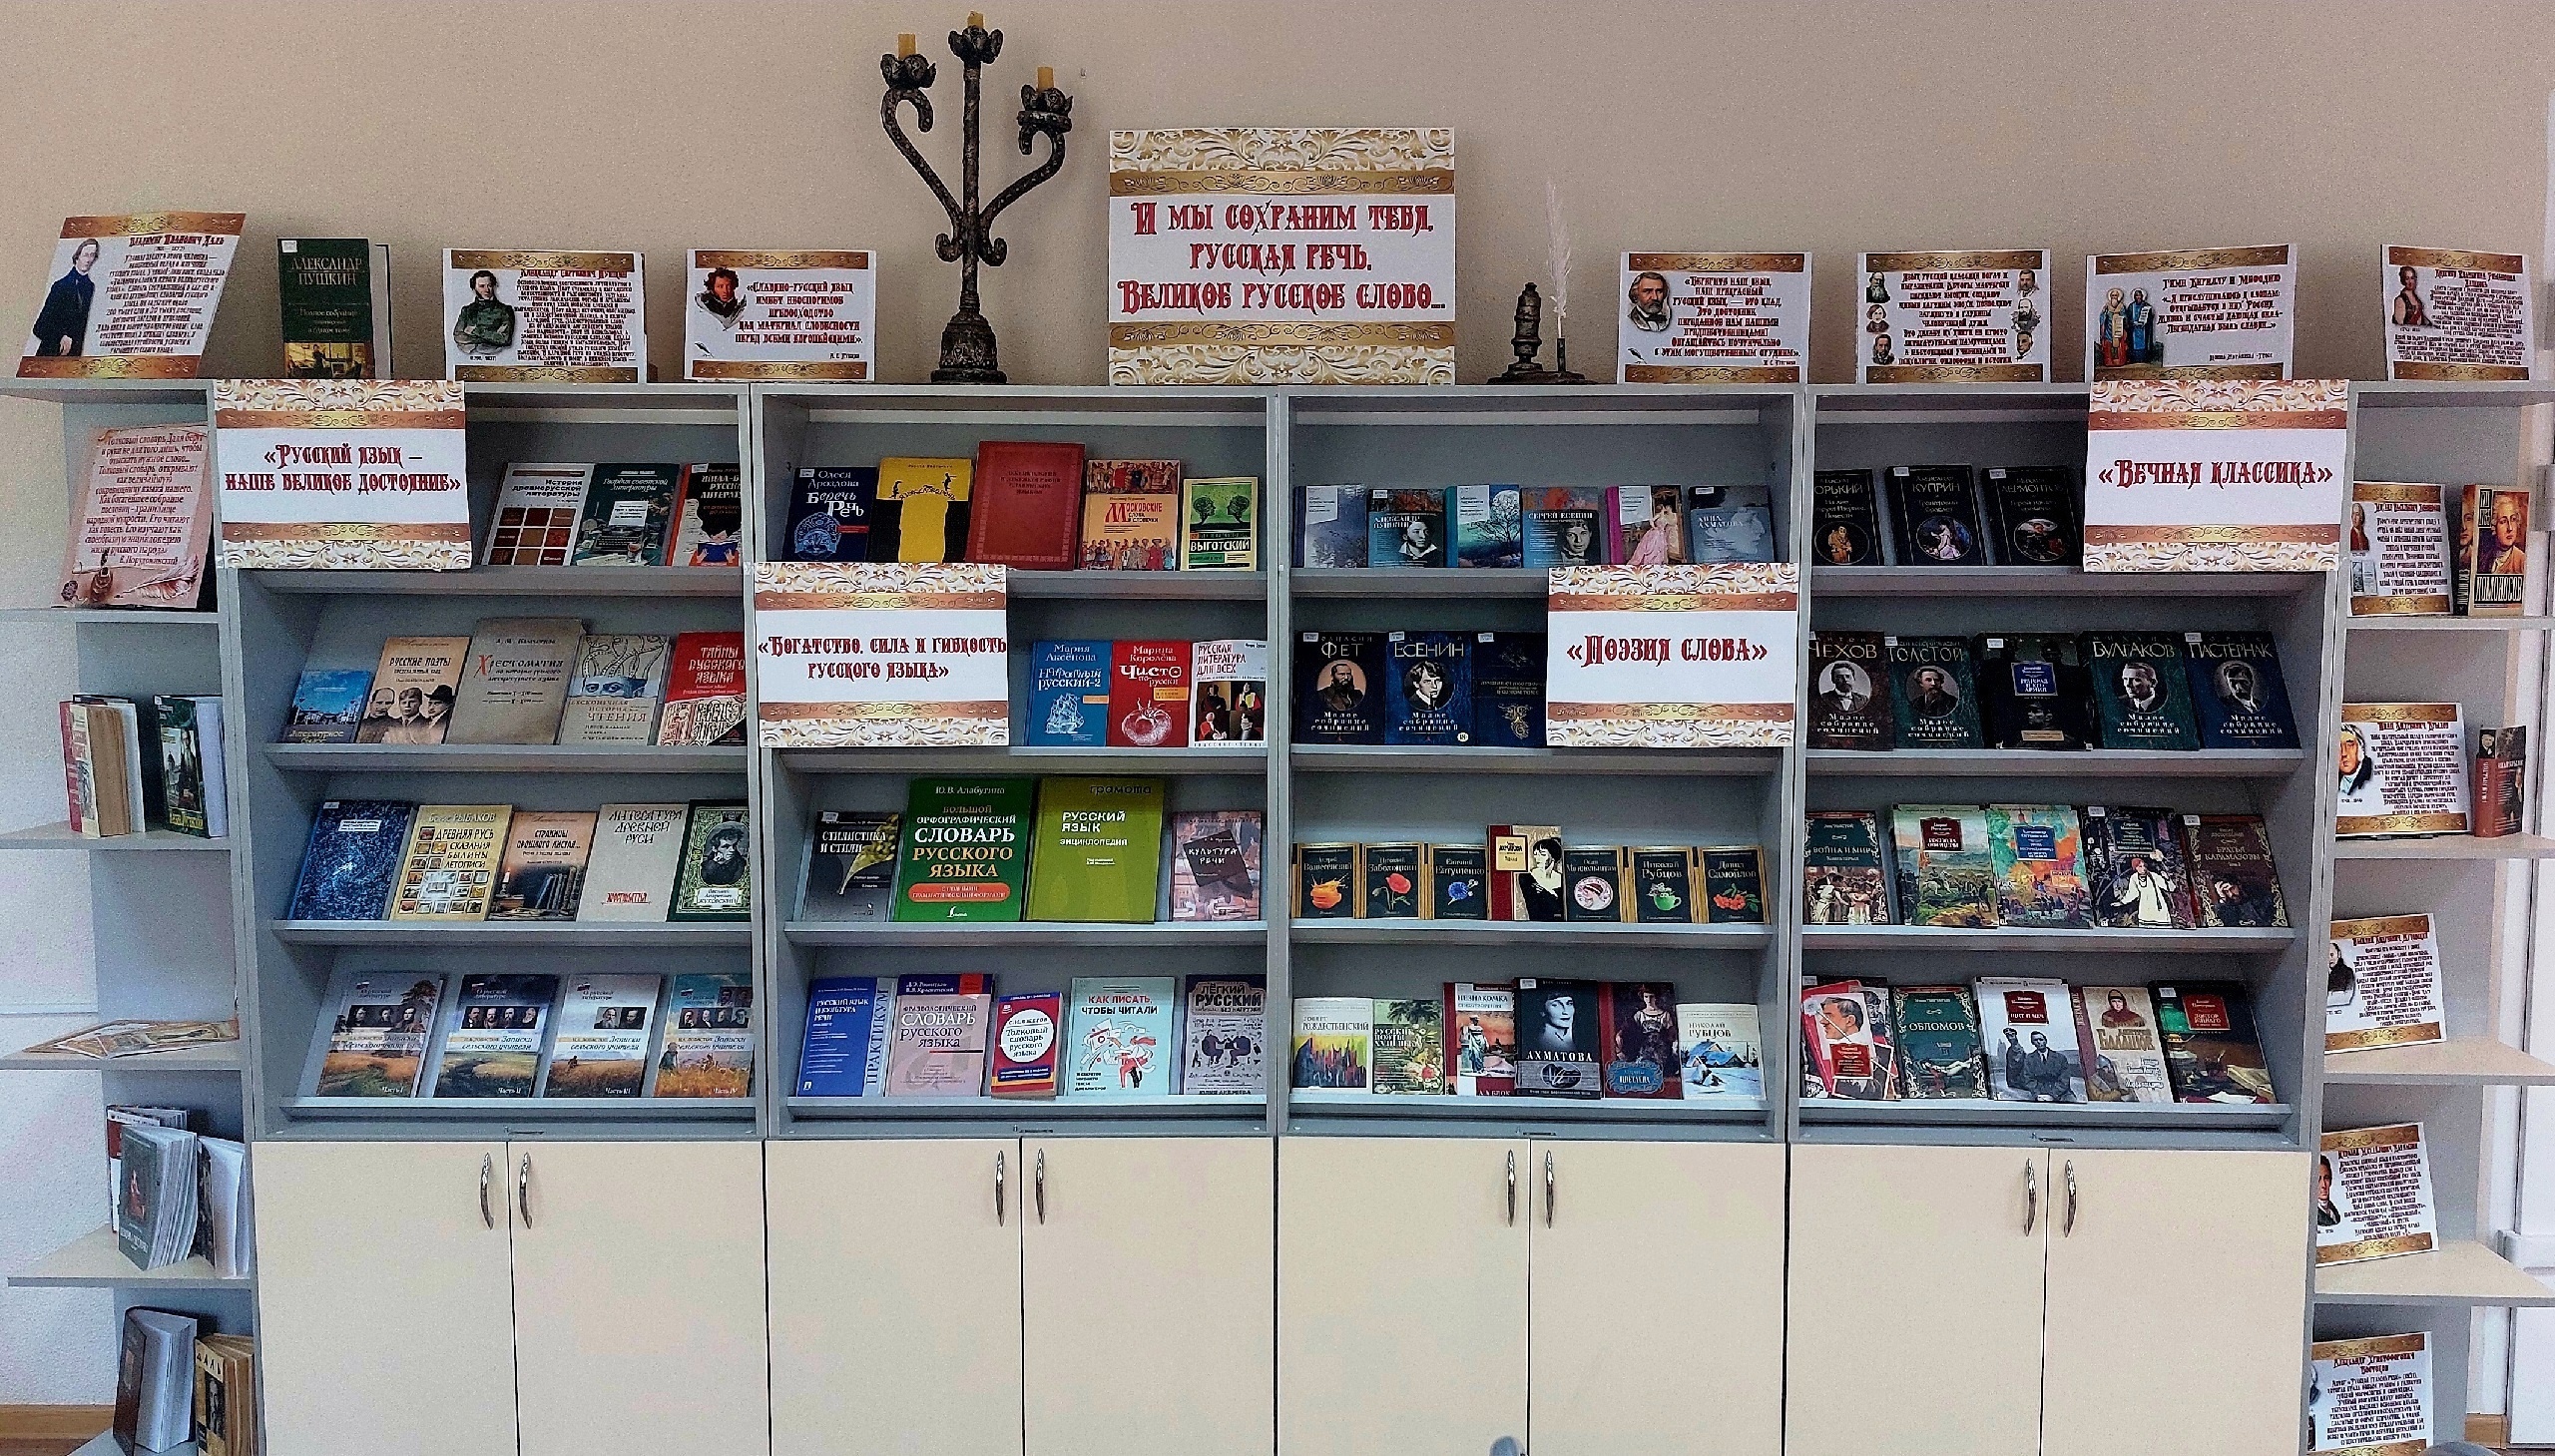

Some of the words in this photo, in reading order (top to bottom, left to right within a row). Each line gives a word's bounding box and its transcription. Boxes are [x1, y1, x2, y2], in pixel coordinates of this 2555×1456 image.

[1131, 203, 1157, 236] И
[291, 257, 362, 269] АЛЕКСАНДР
[299, 273, 356, 285] ПУШКИН
[806, 492, 856, 504] Беречь
[826, 500, 864, 517] Речь
[1105, 502, 1163, 523] МОСКОВСКИЕ
[1191, 540, 1250, 551] ВЫГОТСКИЙ
[701, 645, 739, 658] ТАЙНЫ
[1054, 645, 1090, 654] Мария
[1134, 646, 1173, 655] Марина
[1199, 645, 1232, 655] РУССКАЯ
[1321, 642, 1363, 658] ФЕТ
[1395, 643, 1464, 657] ЕСЕНИН
[1808, 644, 1876, 659] ЧЕХОВ
[1886, 646, 1964, 662] ТОЛСТОЙ
[2093, 642, 2175, 658] БУЛГАКОВ
[2189, 643, 2273, 658] ПАСТЕРНАК
[1130, 654, 1177, 664] Королёва
[1198, 654, 1246, 665] ЛИТЕРАТУРА
[689, 660, 745, 671] РУССКОГО
[1197, 665, 1213, 677] ДЛЯ
[1119, 665, 1182, 679] Чисто
[696, 672, 734, 684] ЯЗЫКА
[1039, 677, 1101, 691] русский-2
[957, 786, 1005, 795] Алабугина
[1091, 785, 1152, 795] грамота
[452, 813, 495, 822] РЫБАКОВ
[609, 810, 683, 820] ЛИТЕРАТУРА
[916, 814, 1016, 824] ОРФОГРАФИЧЕСКИЙ
[1062, 810, 1126, 821] РУССКИЙ
[615, 821, 671, 832] ДРЕВНЕЙ
[1062, 823, 1101, 832] ЯЗЫК
[435, 829, 472, 840] ДРЕВНЯЯ
[474, 829, 494, 839] РУСЬ
[626, 834, 654, 844] РУСИ
[822, 831, 886, 841] СТИЛИСТИКА
[914, 828, 1015, 842] СЛОВАРЬ
[820, 843, 827, 852] И
[913, 847, 1013, 860] РУССКОГО
[928, 864, 998, 877] ЯЗЫКА
[1642, 869, 1682, 879] Рубцов
[1709, 869, 1756, 878] Самойлов
[1202, 983, 1246, 994] ЛЁГКИЙ
[1196, 994, 1262, 1006] РУССКИЙ
[901, 1012, 975, 1026] СЛОВАРЬ
[1006, 1026, 1048, 1036] Толковый
[1302, 1022, 1369, 1031] РОЖДЕСТВЕНСКИЙ
[1909, 1022, 1964, 1031] ОБЛОМОВ
[866, 989, 888, 1085] ПРАКТИКУМ
[900, 1028, 962, 1041] русского
[1689, 1029, 1732, 1039] РУБЦОВ
[918, 1038, 960, 1048] языка
[1526, 1051, 1593, 1062] АХМАТОВА
